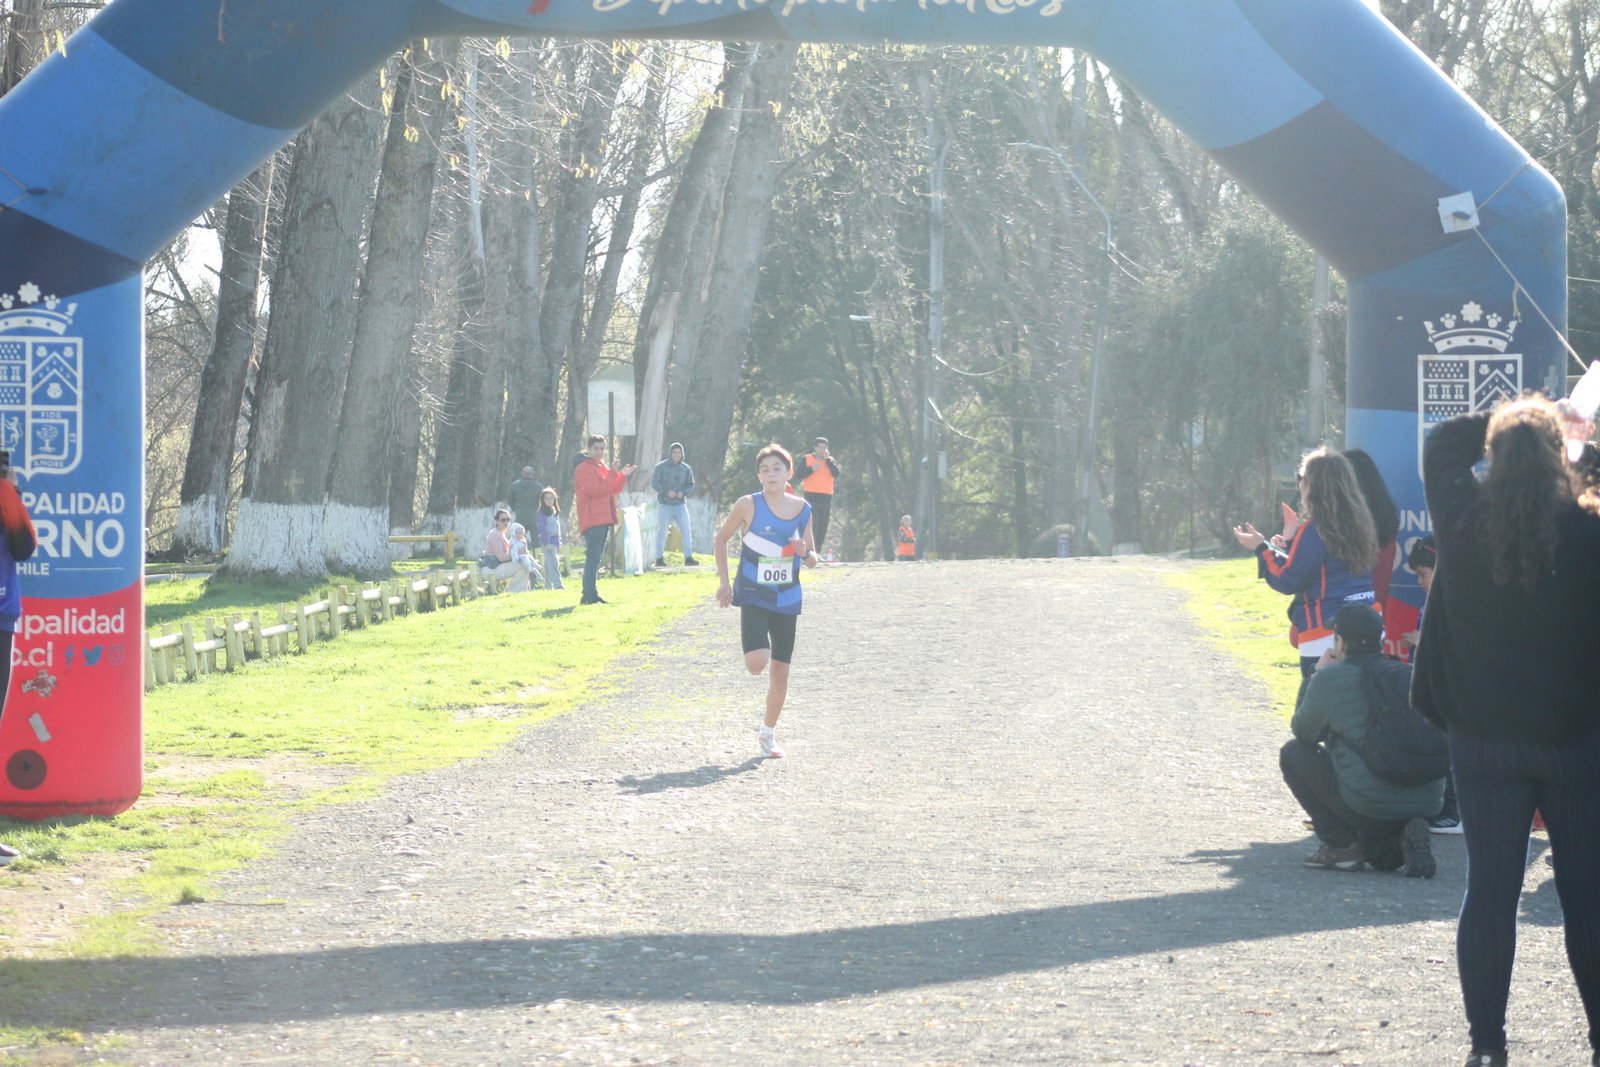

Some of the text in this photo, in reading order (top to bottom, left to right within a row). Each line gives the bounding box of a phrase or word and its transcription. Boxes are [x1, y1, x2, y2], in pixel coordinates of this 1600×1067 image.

[40, 411, 62, 419] FIDE
[33, 459, 65, 468] AMORE
[21, 492, 125, 515] PALIDAD
[31, 518, 125, 558] RNO
[15, 562, 50, 576] HILE
[763, 569, 787, 582] 006
